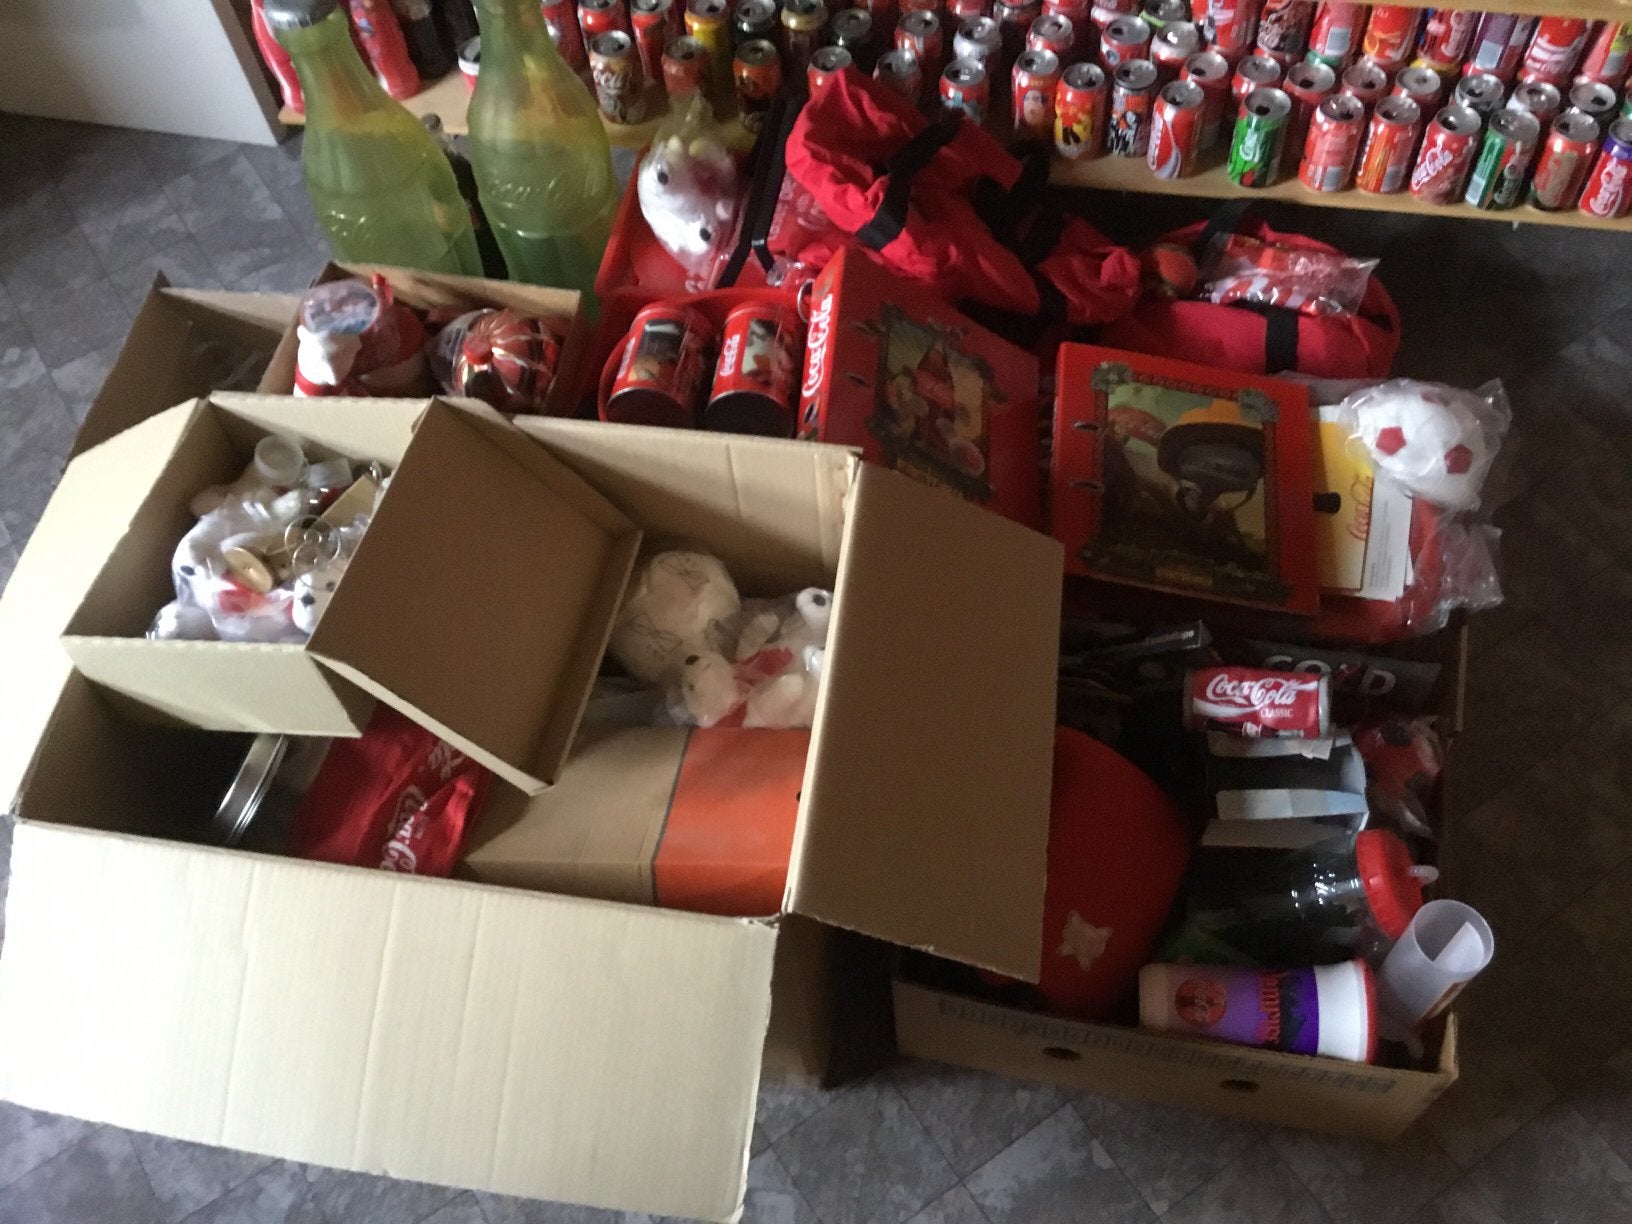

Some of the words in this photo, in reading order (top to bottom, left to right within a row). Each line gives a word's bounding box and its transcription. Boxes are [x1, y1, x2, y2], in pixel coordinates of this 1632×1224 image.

[802, 292, 833, 397] Coca-Cola
[1206, 671, 1319, 706] Coca-Cola
[1260, 706, 1296, 719] CLASSIC
